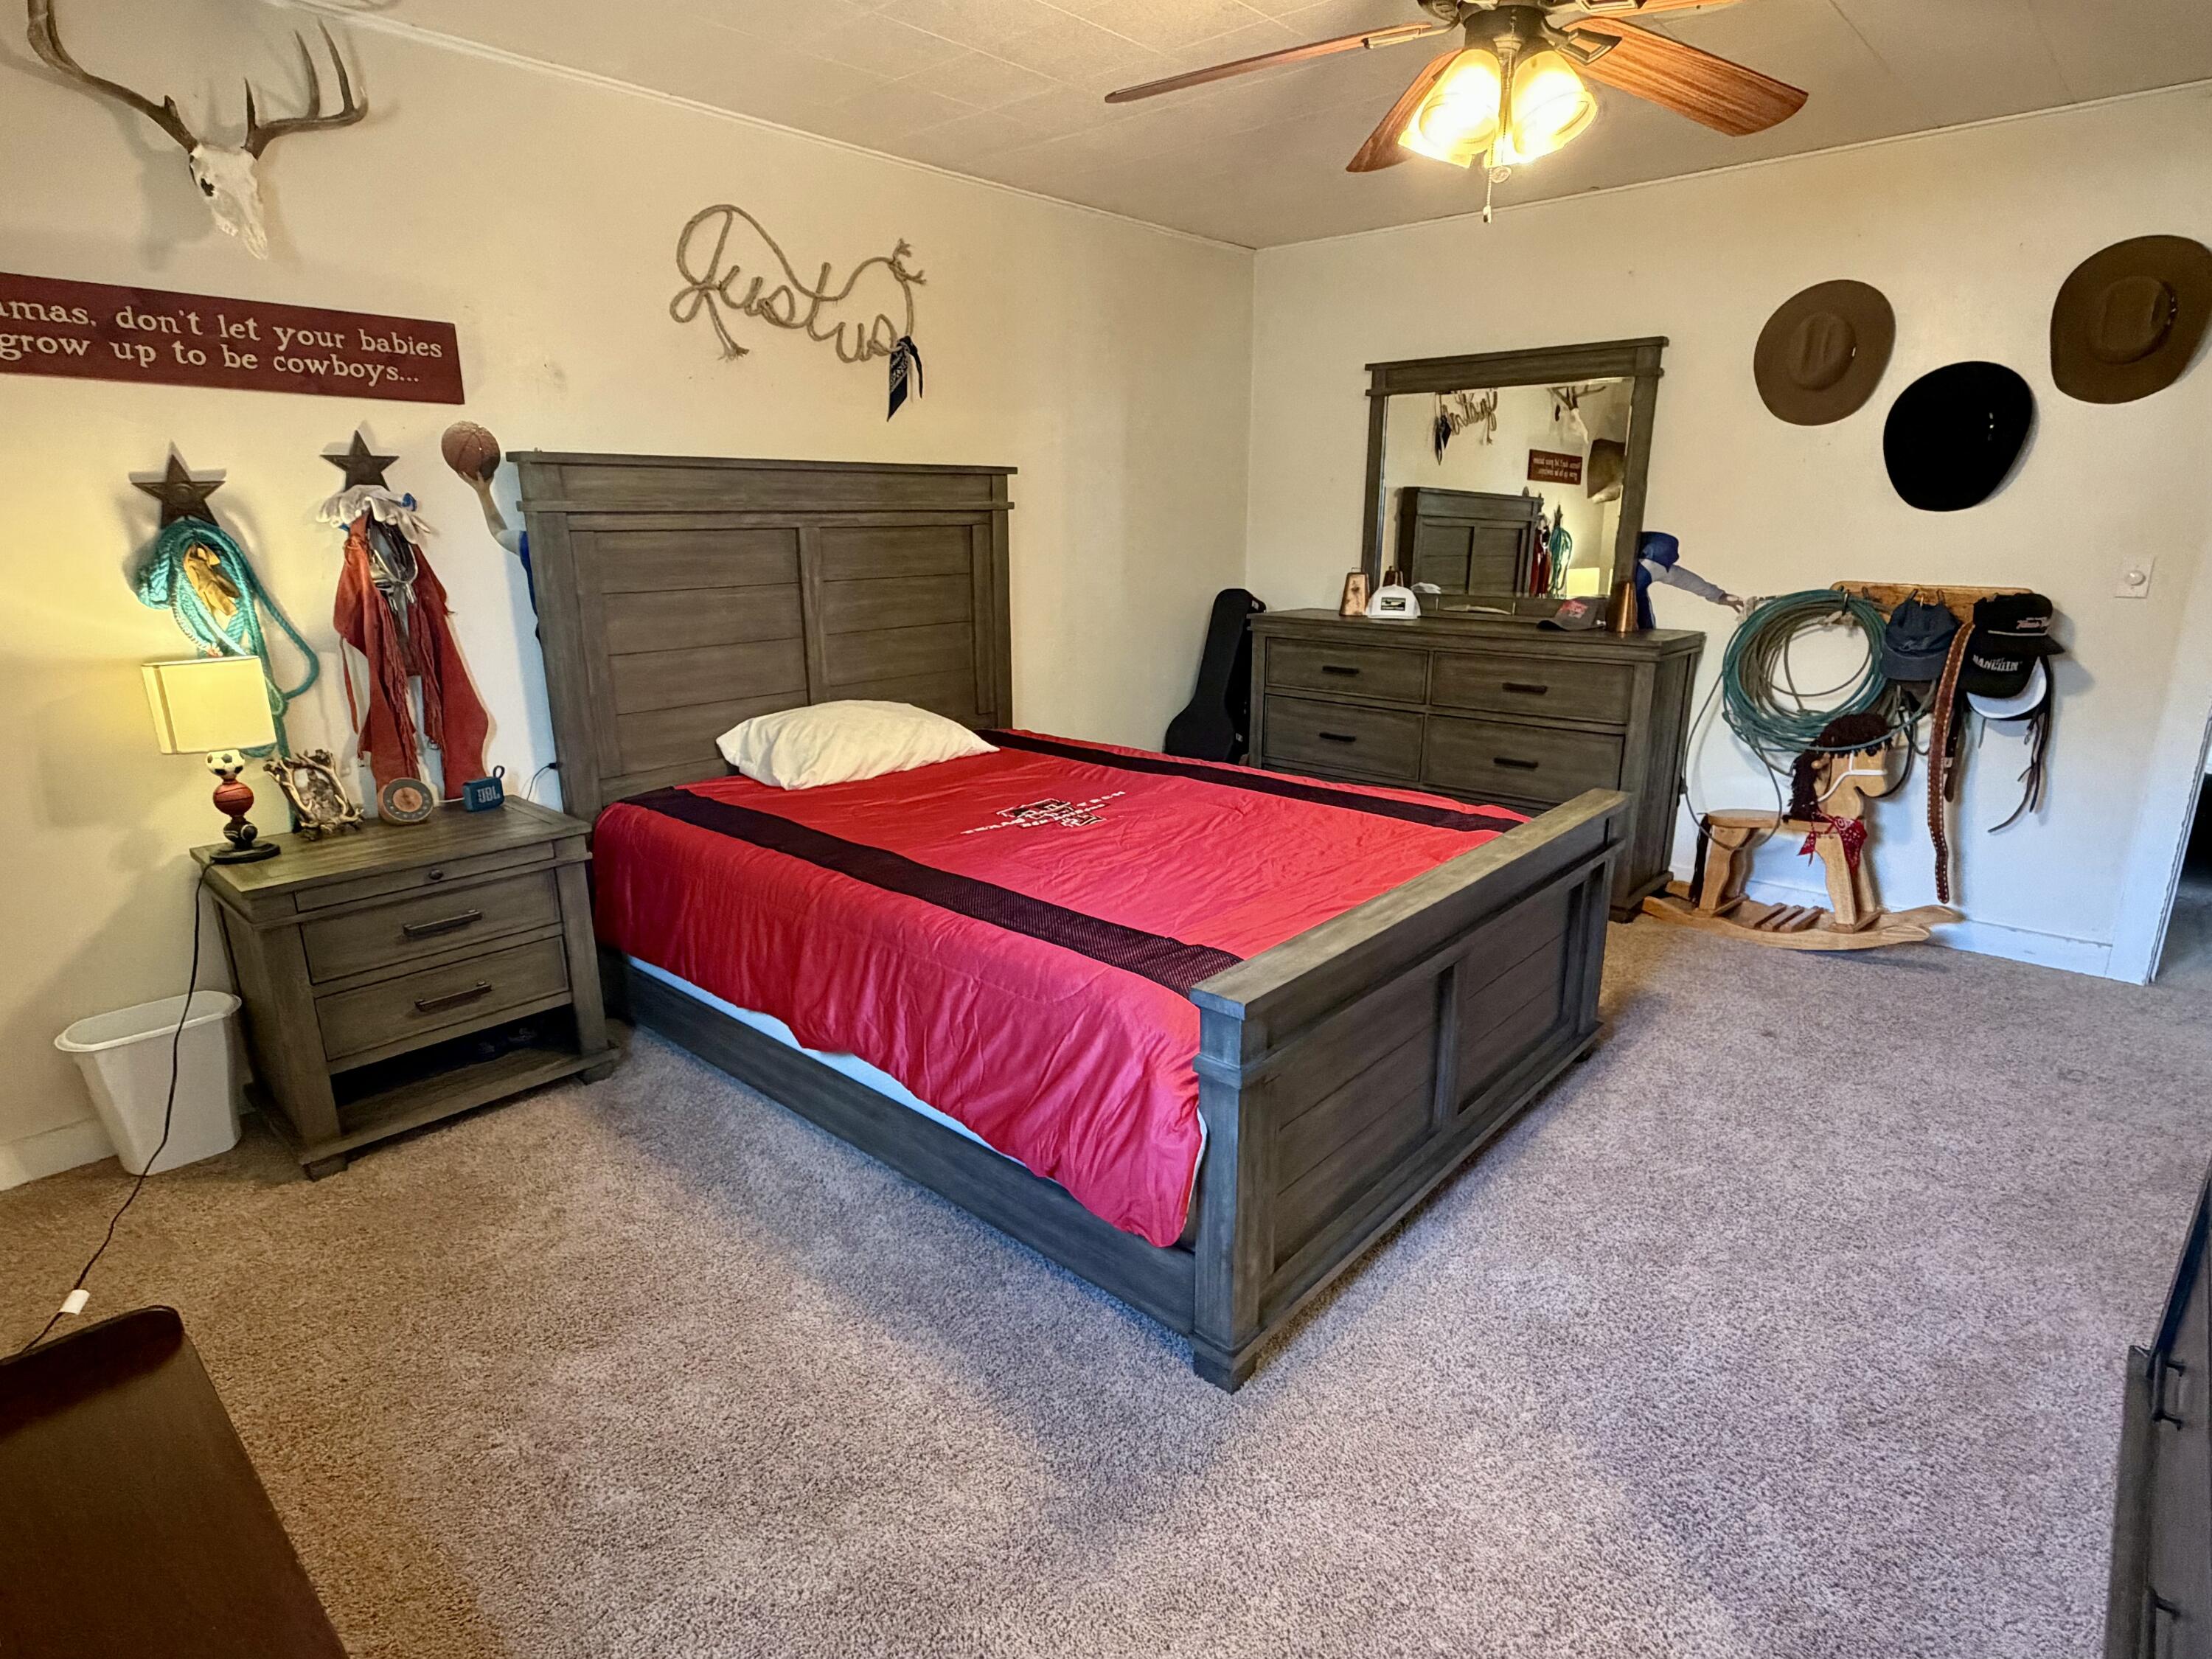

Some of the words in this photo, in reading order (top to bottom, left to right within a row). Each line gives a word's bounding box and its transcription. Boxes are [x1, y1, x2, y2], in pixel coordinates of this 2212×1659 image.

[116, 305, 204, 335] don't
[217, 314, 261, 341] let
[273, 326, 345, 352] your
[358, 328, 442, 358] babies
[0, 333, 91, 361] grow
[110, 341, 156, 368] up
[172, 340, 206, 366] to
[220, 344, 258, 369] be
[274, 353, 419, 387] cowboys...
[477, 785, 501, 803] JBL
